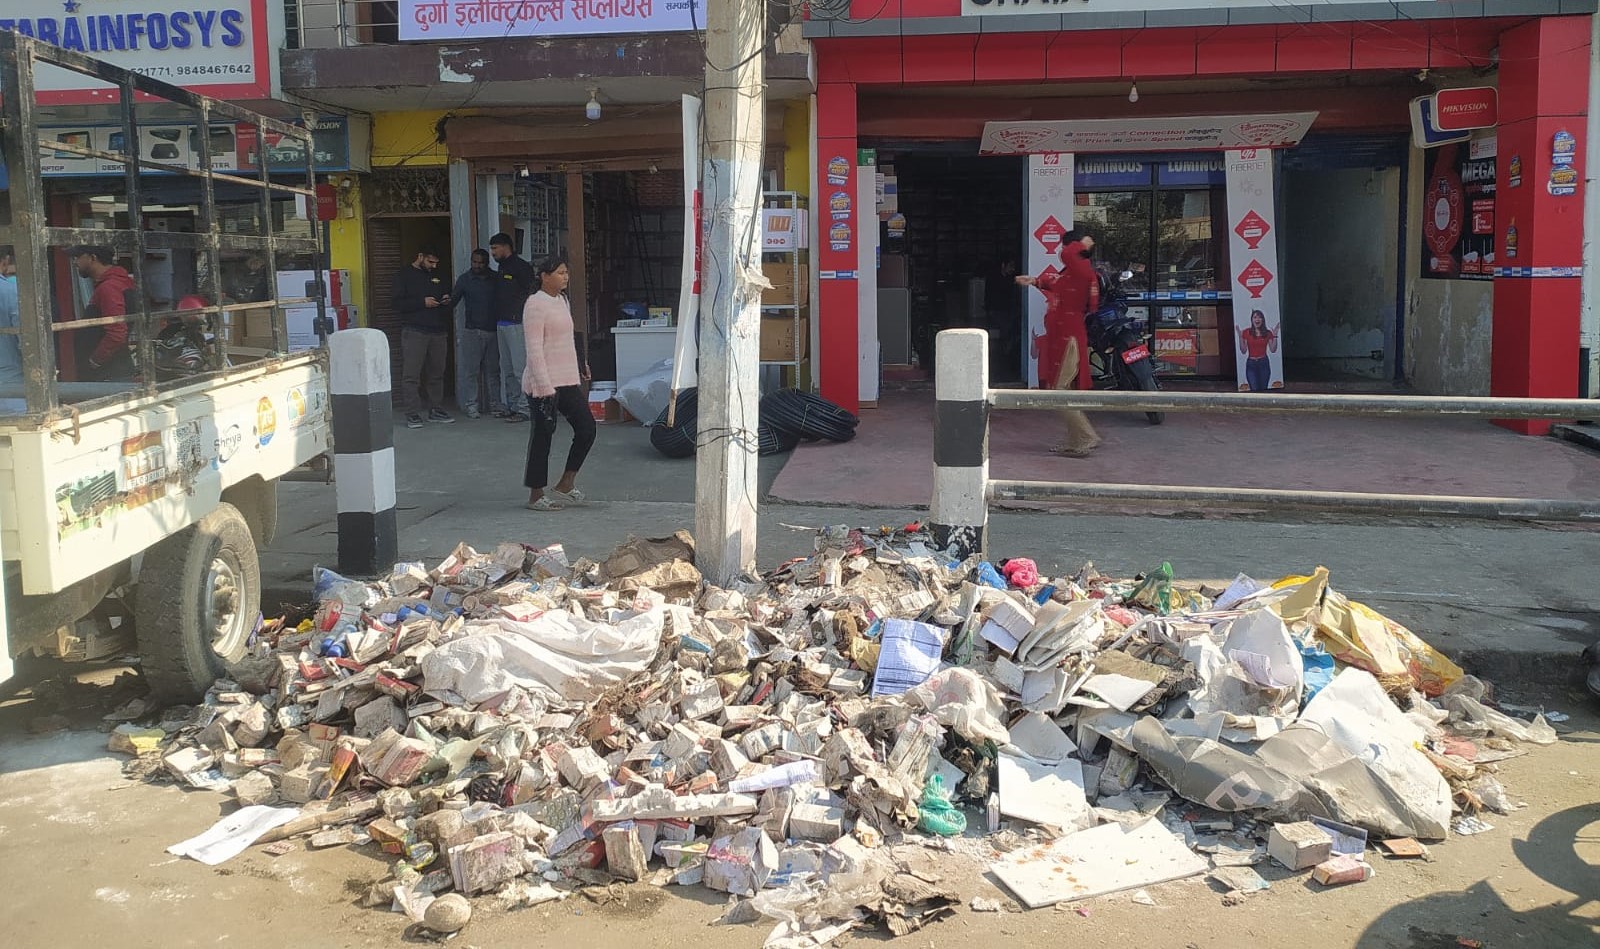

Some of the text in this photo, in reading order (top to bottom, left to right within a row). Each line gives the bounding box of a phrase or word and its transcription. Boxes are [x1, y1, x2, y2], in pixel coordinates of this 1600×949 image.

[177, 64, 252, 76] 9848467642
[1443, 102, 1489, 114] HIKVISION
[41, 164, 65, 172] APTOP
[1078, 161, 1143, 174] LUMINOUS
[1167, 160, 1226, 173] LUMINOU
[1461, 160, 1496, 184] MEGA
[1154, 338, 1193, 351] EXIDE
[213, 431, 242, 449] Shriya
